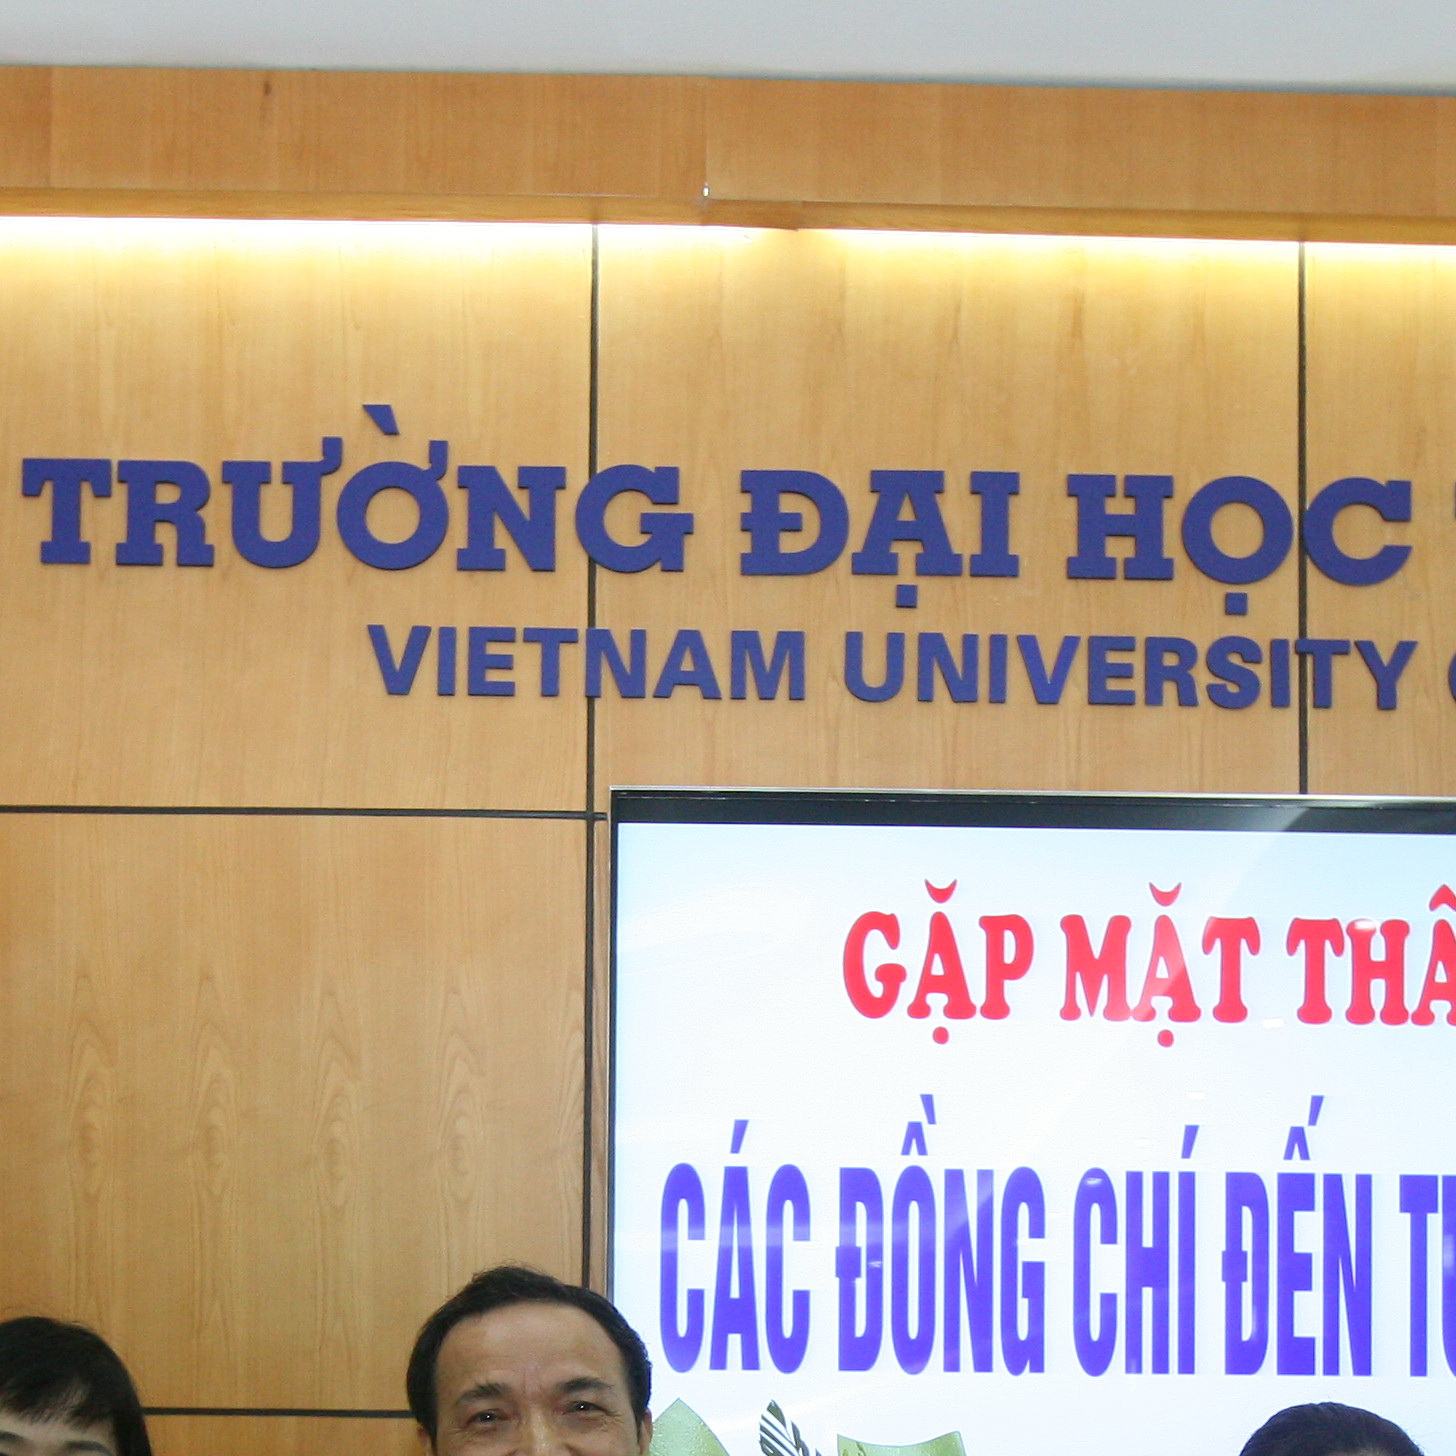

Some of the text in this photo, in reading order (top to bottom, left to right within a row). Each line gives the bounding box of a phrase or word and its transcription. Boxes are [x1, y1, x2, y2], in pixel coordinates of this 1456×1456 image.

[23, 405, 693, 572] TRƯỜNG
[741, 470, 1019, 608] ĐẠI
[1068, 474, 1411, 616] HỌC
[368, 624, 806, 701] VIETNAM
[845, 632, 1417, 710] UNIVERSITY
[843, 880, 1034, 1045] GẶP
[1060, 883, 1261, 1047] MẶT
[659, 1118, 811, 1374] CÁC
[835, 1093, 1046, 1377] ĐỒNG
[1073, 1124, 1199, 1377] CHÍ
[1221, 1095, 1373, 1377] ĐẾN
